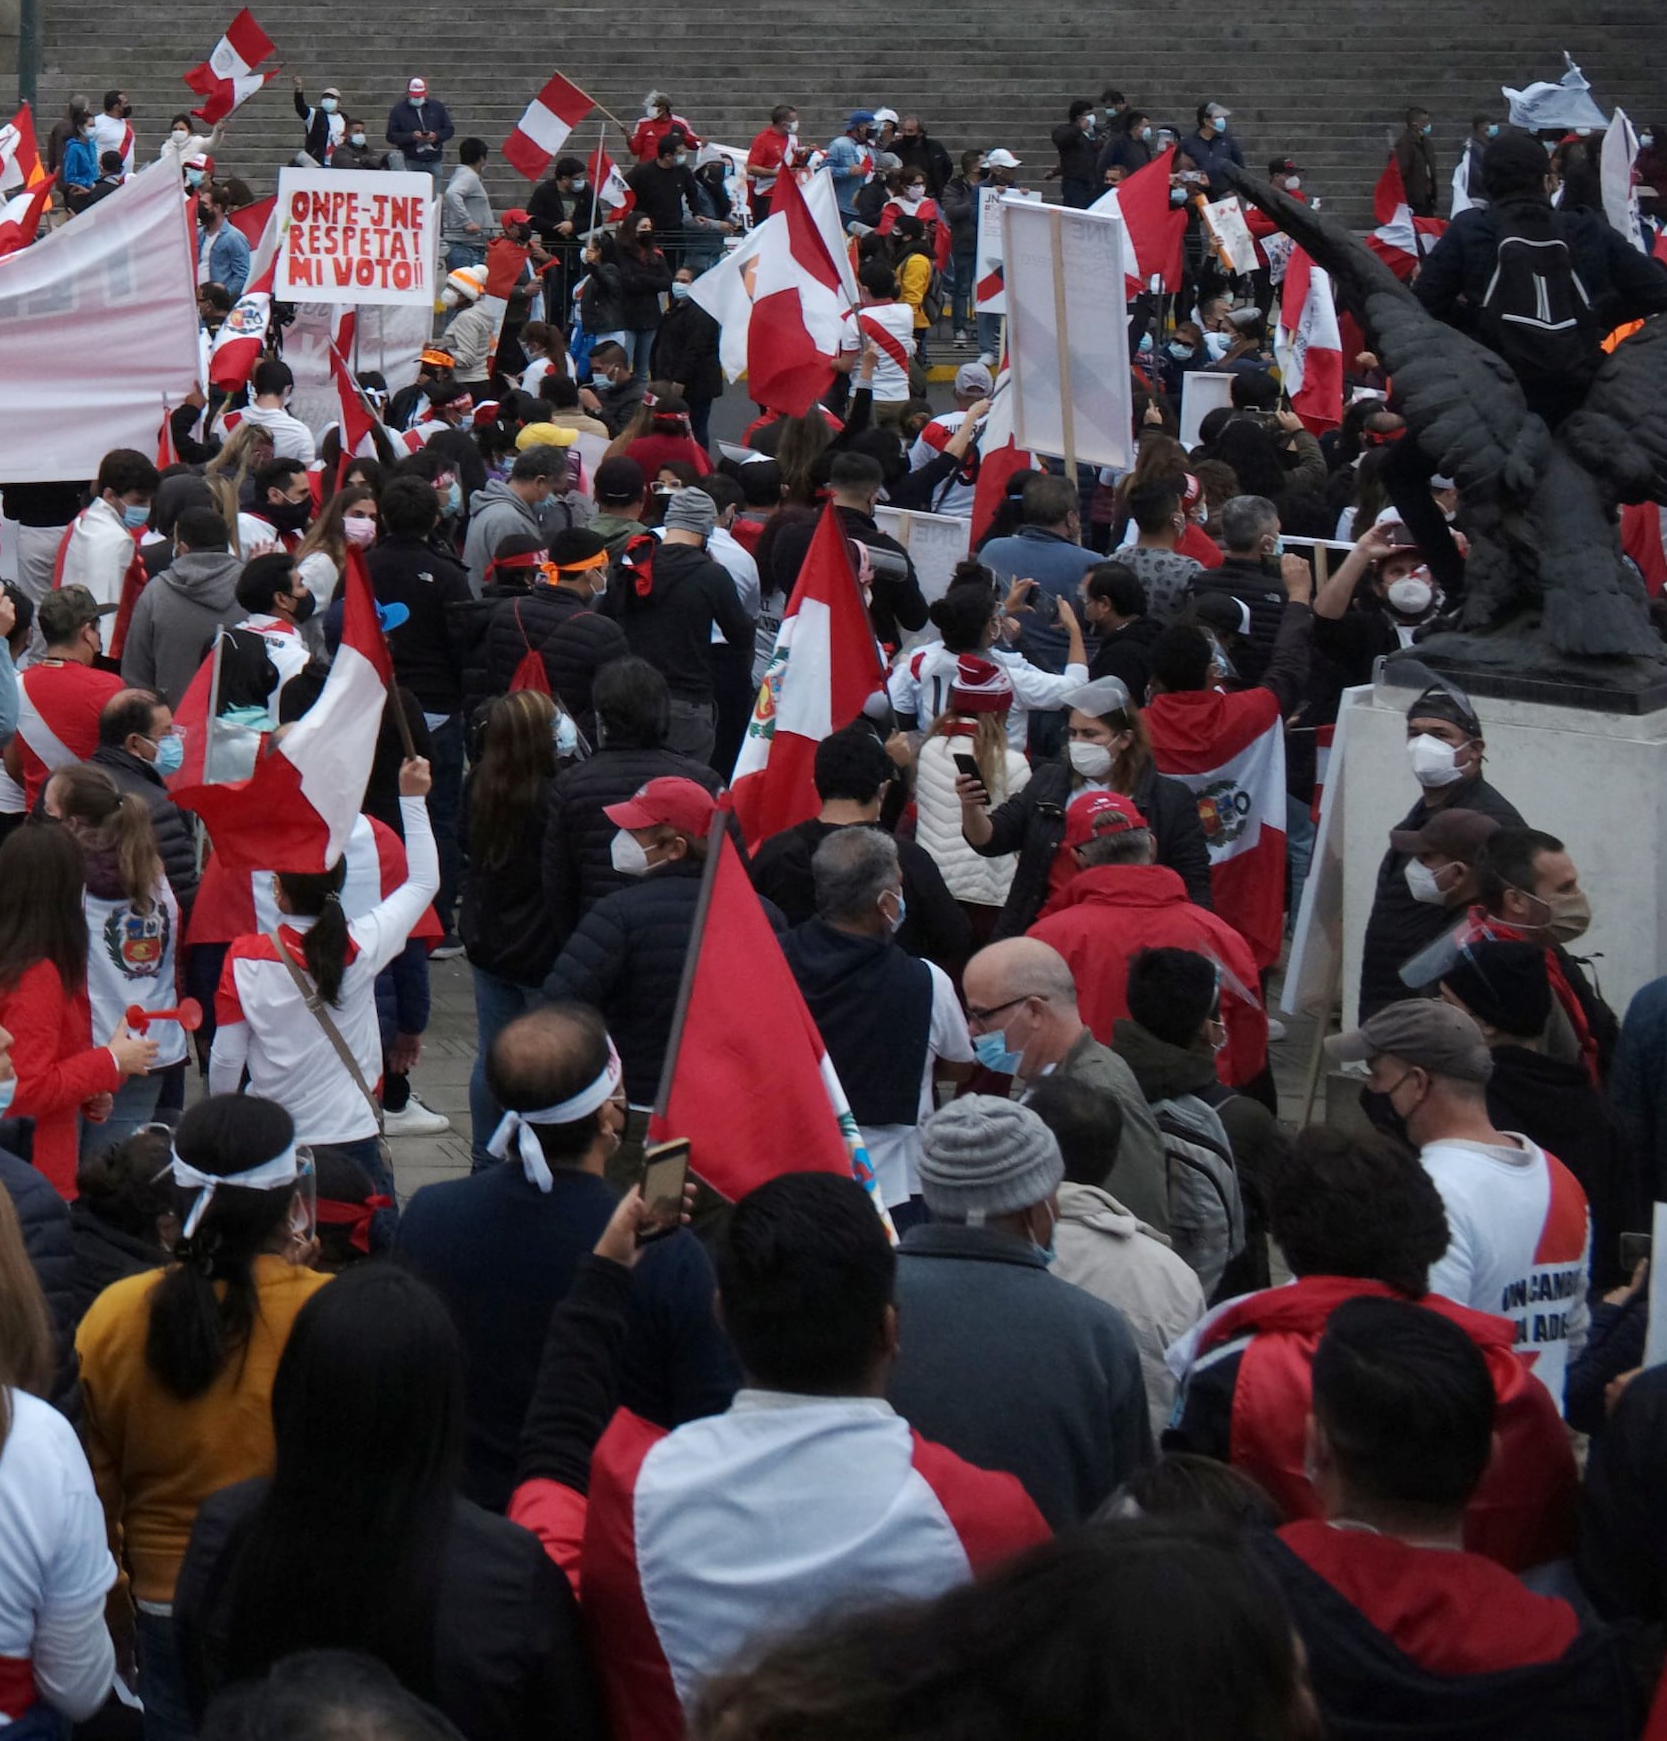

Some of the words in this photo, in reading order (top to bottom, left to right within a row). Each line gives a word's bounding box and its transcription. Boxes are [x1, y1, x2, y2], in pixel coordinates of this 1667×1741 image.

[291, 190, 425, 230] ONPE-JNE
[984, 193, 1001, 204] JN
[288, 224, 420, 262] RESPETA!
[287, 255, 324, 287] MI
